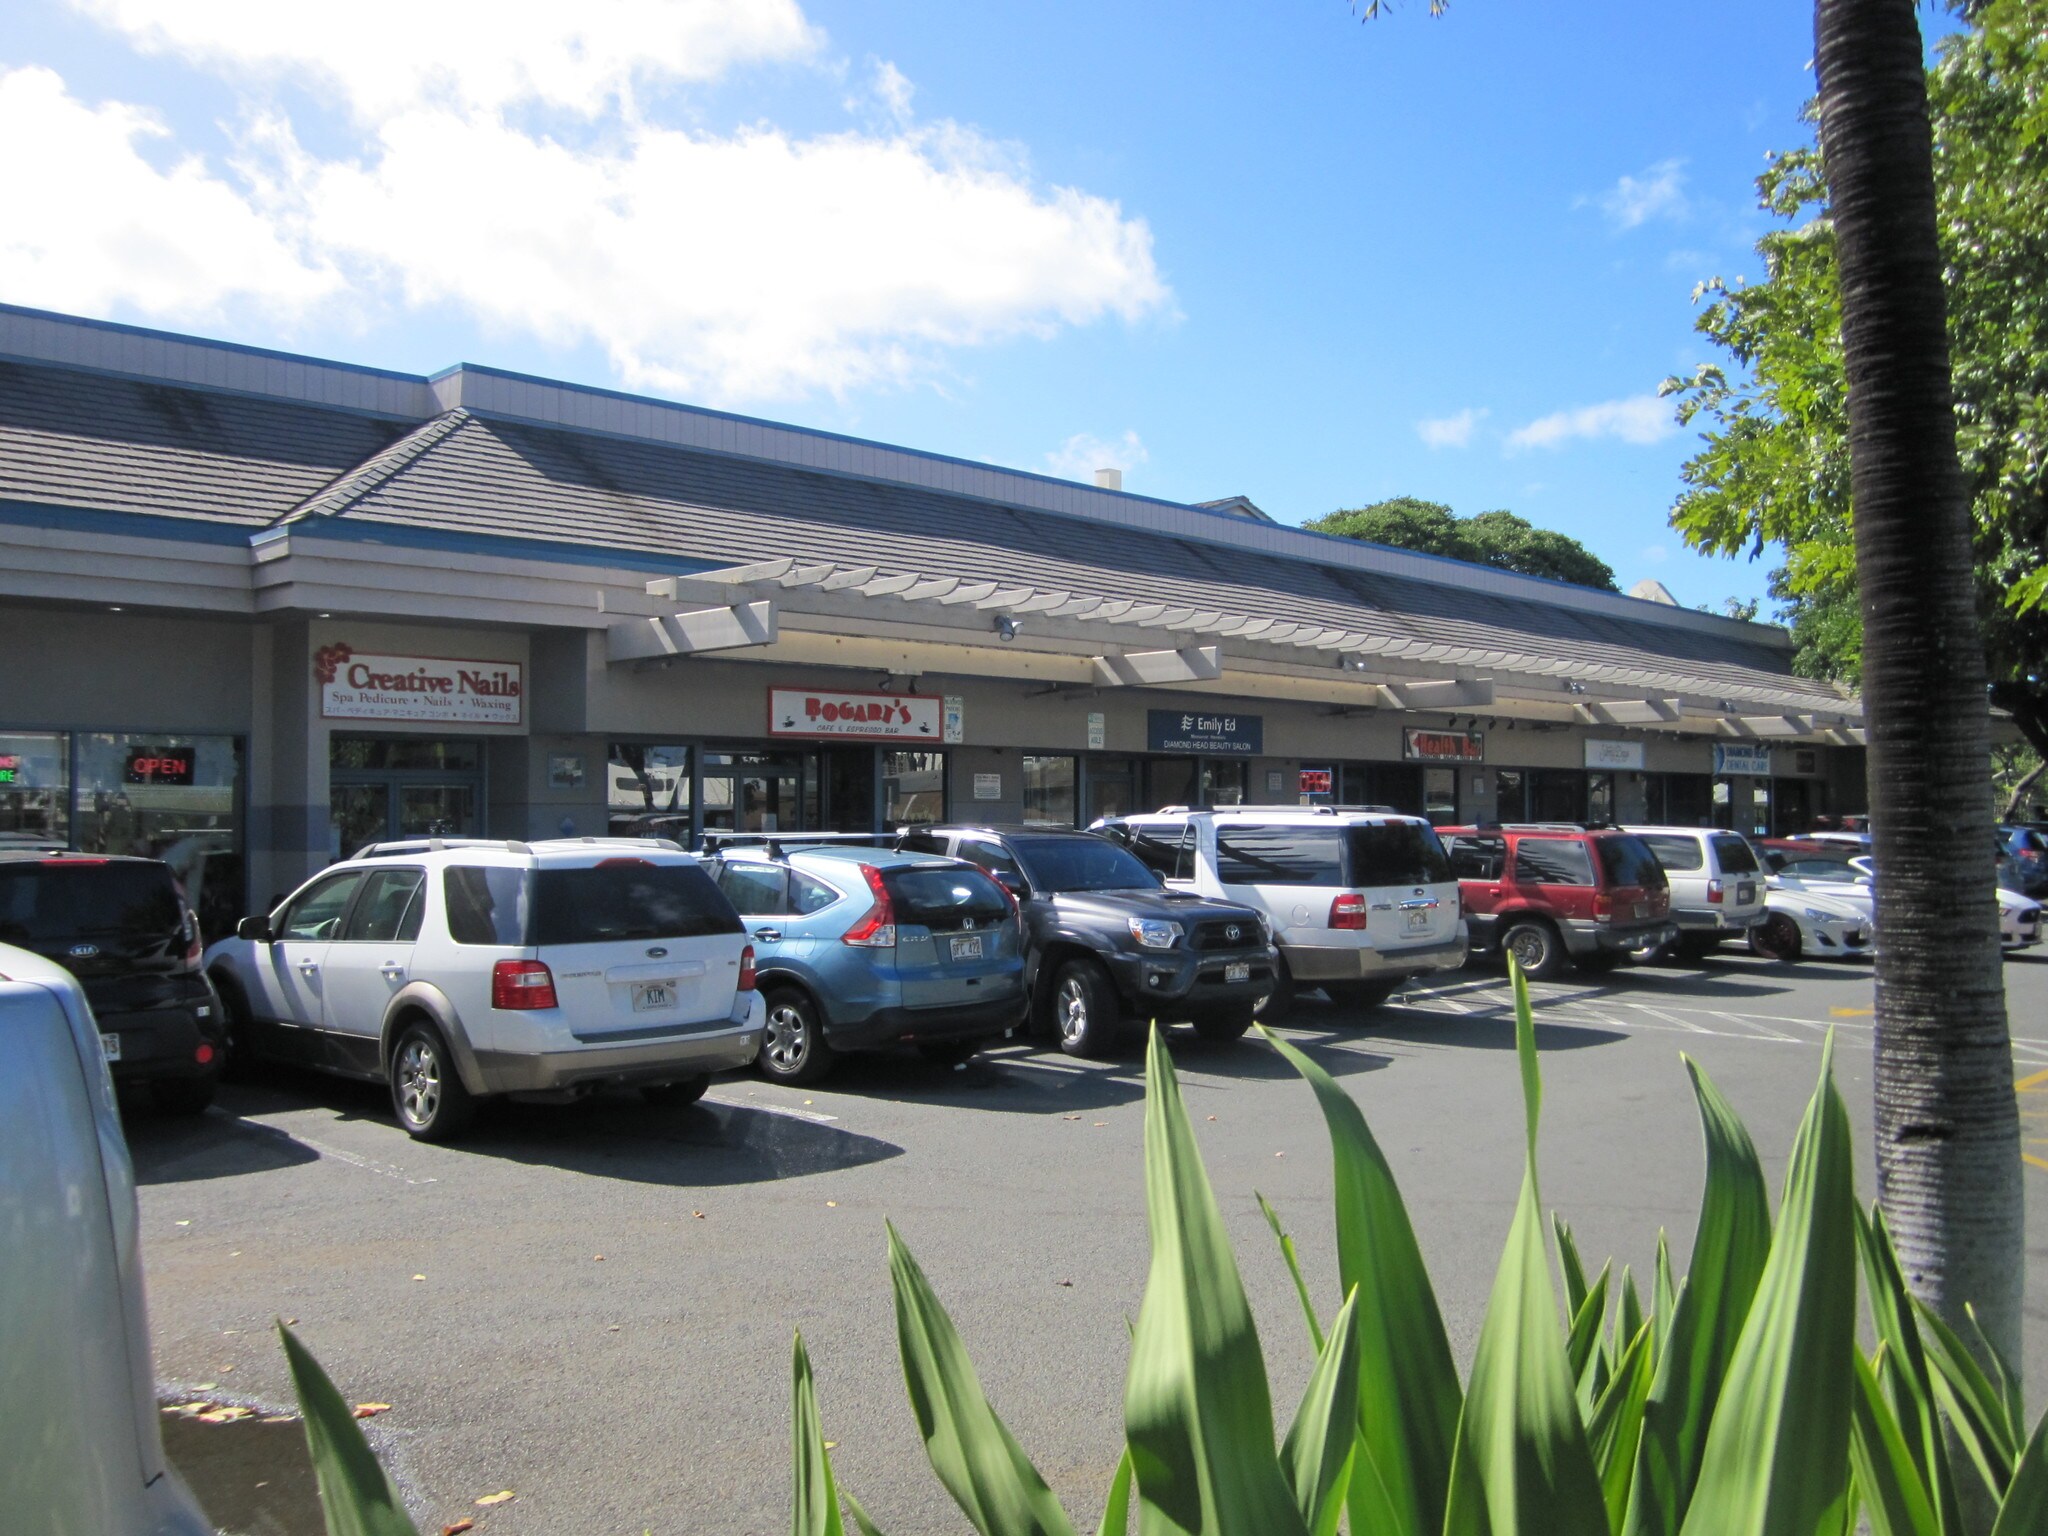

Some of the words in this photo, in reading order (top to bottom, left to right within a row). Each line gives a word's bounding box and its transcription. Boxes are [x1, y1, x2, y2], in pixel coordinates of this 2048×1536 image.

[348, 664, 453, 694] Creative
[457, 669, 521, 697] Nails
[332, 692, 354, 704] Spa
[359, 692, 409, 706] Pedicure
[424, 696, 453, 707] Nails
[471, 698, 512, 711] Waxing
[805, 697, 912, 725] BOGART'S
[846, 725, 882, 733] ESPRESSO
[1197, 717, 1222, 735] Emily
[1224, 718, 1236, 731] Ed
[1164, 740, 1192, 749] DIAMOND
[1192, 741, 1209, 749] HEAD
[1209, 742, 1231, 750] BEAUTY
[1232, 742, 1251, 751] SALON
[1419, 733, 1457, 754] Health
[133, 758, 187, 775] OPEN
[1300, 772, 1331, 792] OPEN
[75, 947, 95, 955] KIA
[646, 988, 666, 1004] KIM
